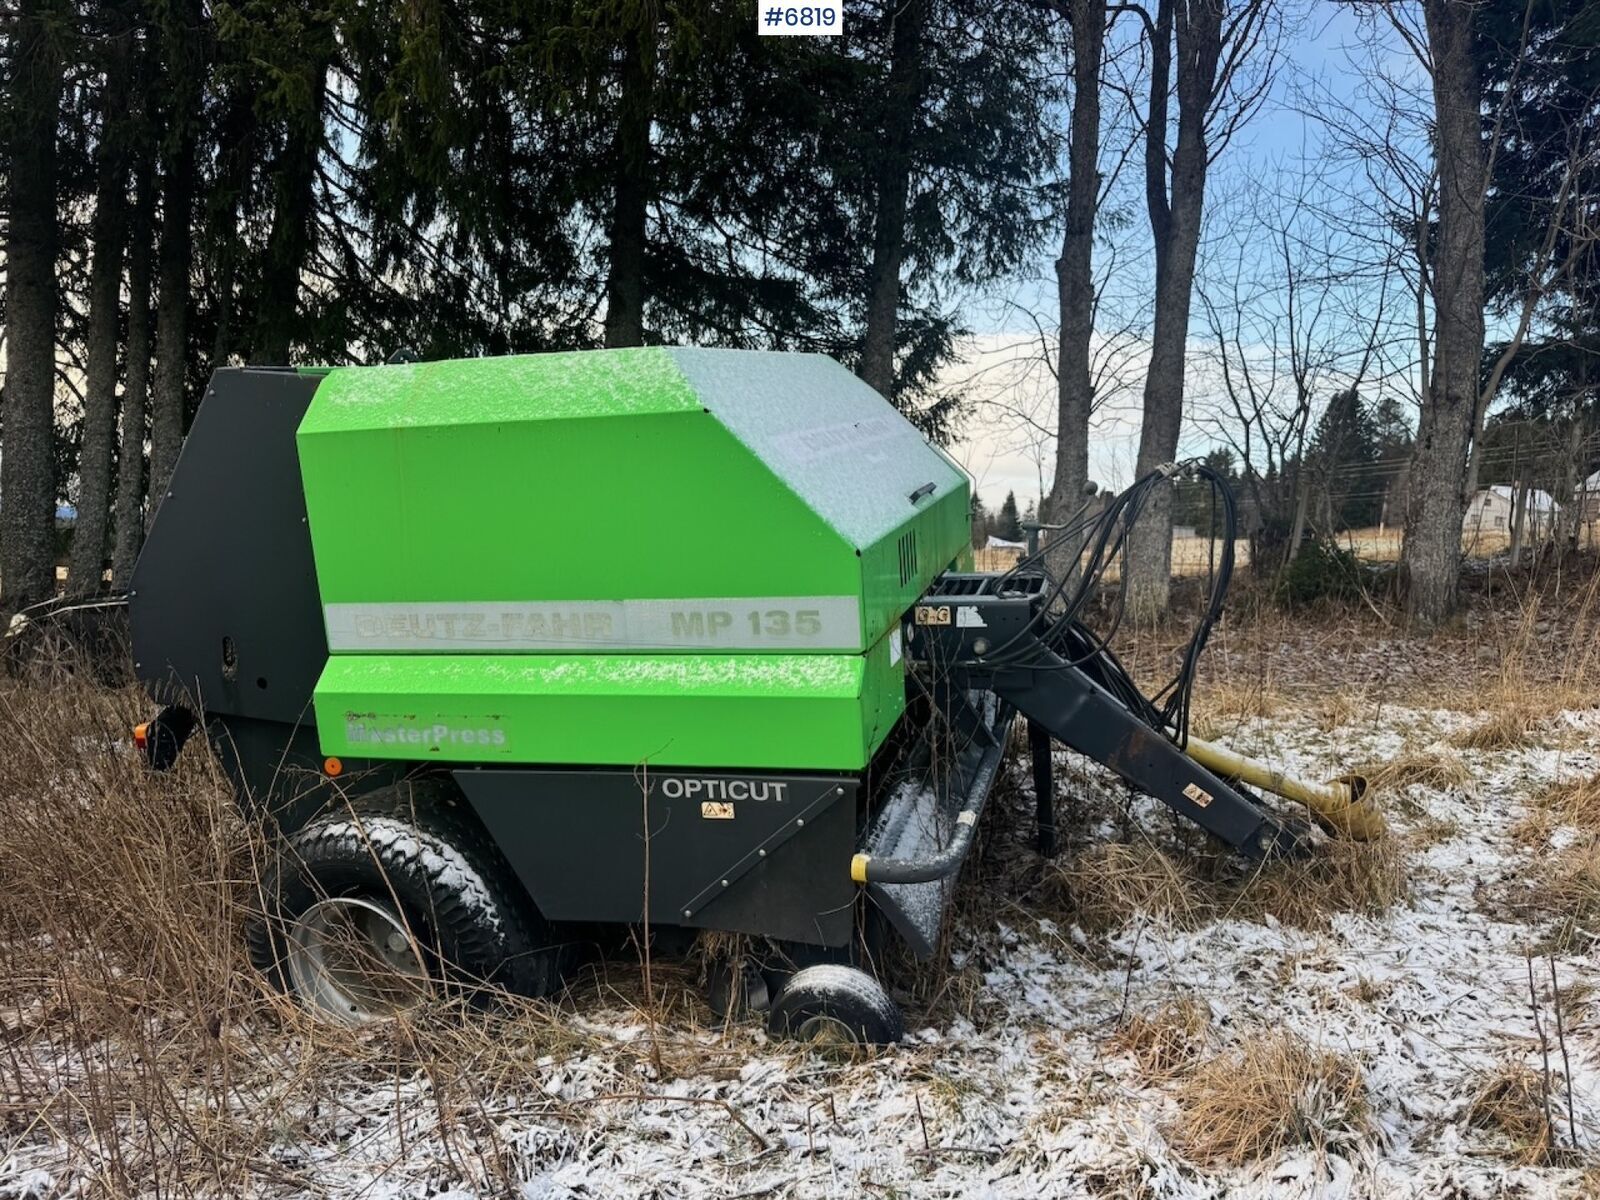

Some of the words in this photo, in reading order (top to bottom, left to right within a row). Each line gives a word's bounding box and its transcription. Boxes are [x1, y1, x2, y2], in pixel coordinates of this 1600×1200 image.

[354, 612, 613, 639] DEUTZ-FAHR
[671, 611, 733, 637] MP
[747, 609, 823, 636] 135
[346, 721, 506, 746] MasterPress
[661, 778, 788, 802] OPTICUT
